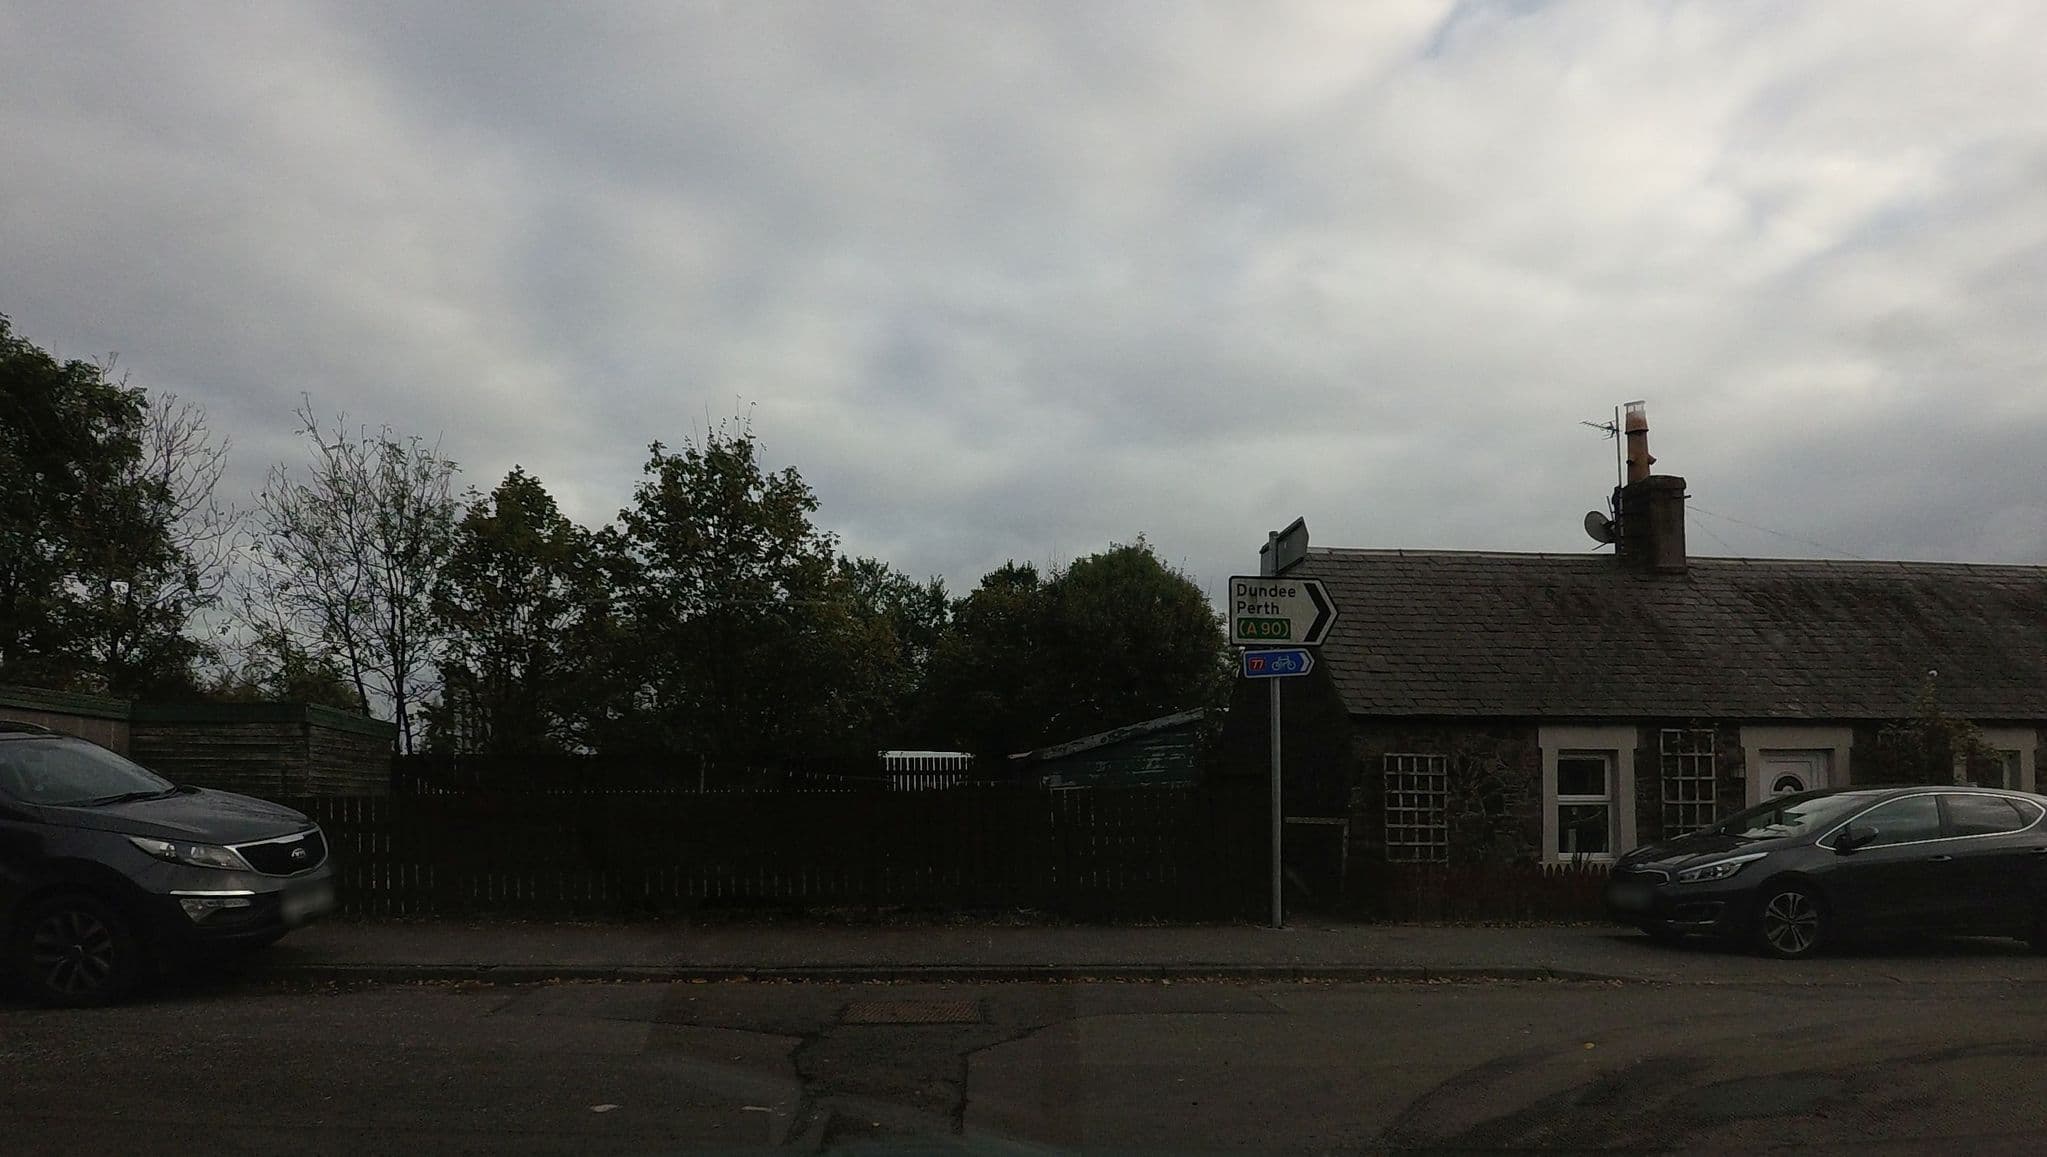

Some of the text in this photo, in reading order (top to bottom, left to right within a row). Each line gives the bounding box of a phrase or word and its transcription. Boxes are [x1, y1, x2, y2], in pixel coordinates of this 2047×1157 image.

[1237, 584, 1296, 597] Dundee
[1237, 601, 1280, 614] Perth
[1250, 659, 1265, 670] 77
